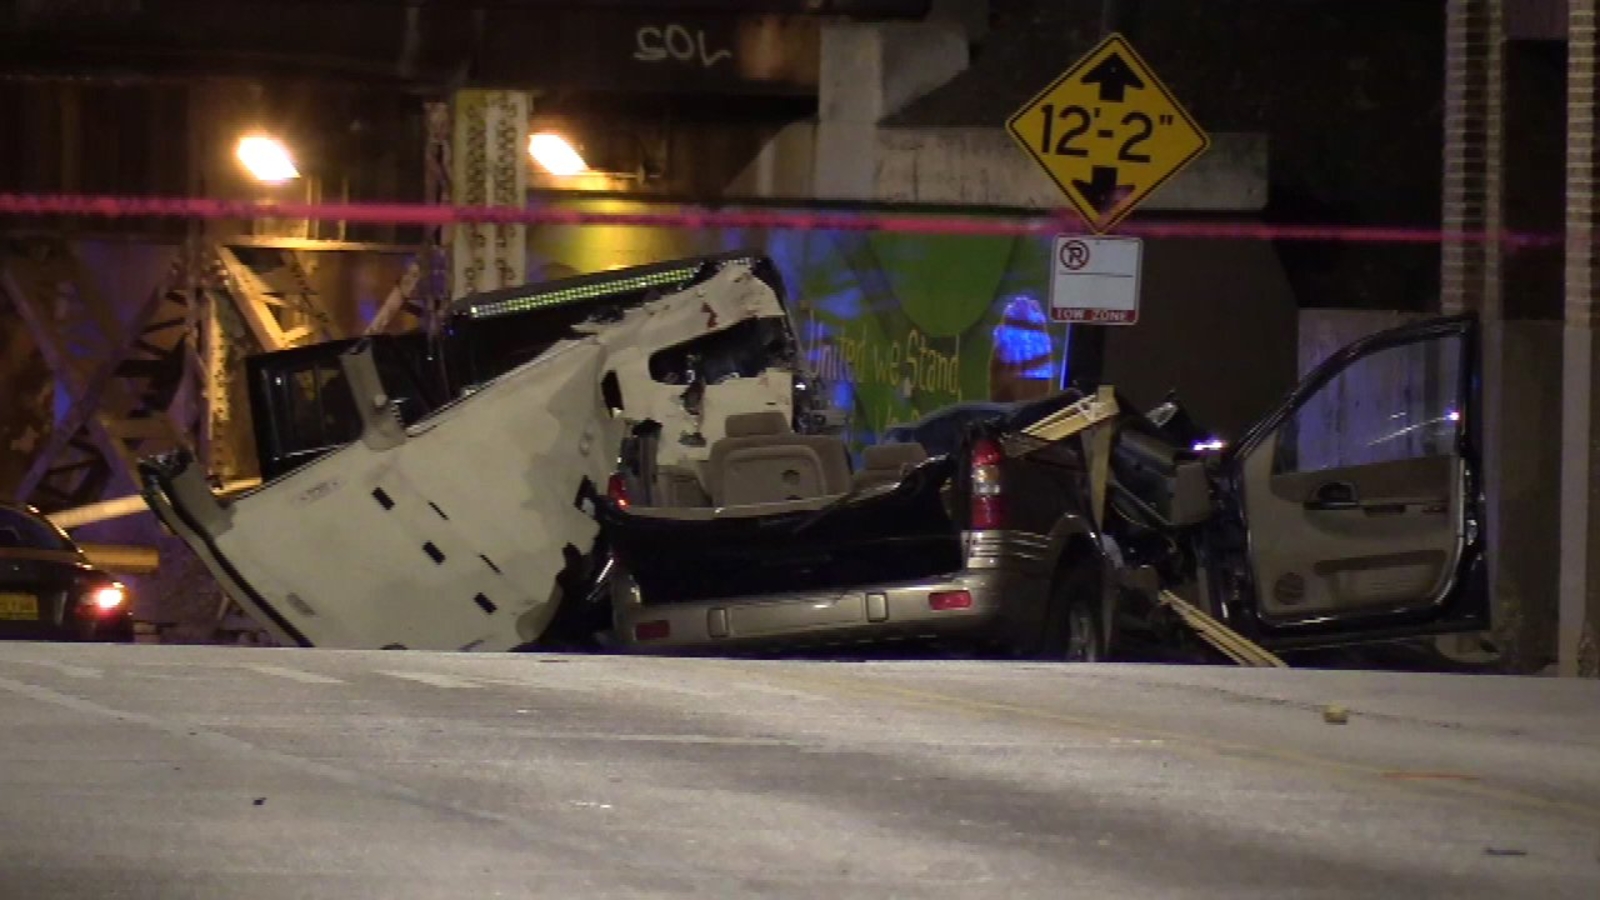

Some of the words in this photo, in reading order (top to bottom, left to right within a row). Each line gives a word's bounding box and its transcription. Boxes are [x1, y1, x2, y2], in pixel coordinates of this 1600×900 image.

[1040, 104, 1174, 163] 12'-2"
[1056, 309, 1084, 320] TOW
[1092, 310, 1127, 321] ZONE
[808, 310, 867, 383] United
[873, 340, 900, 386] we
